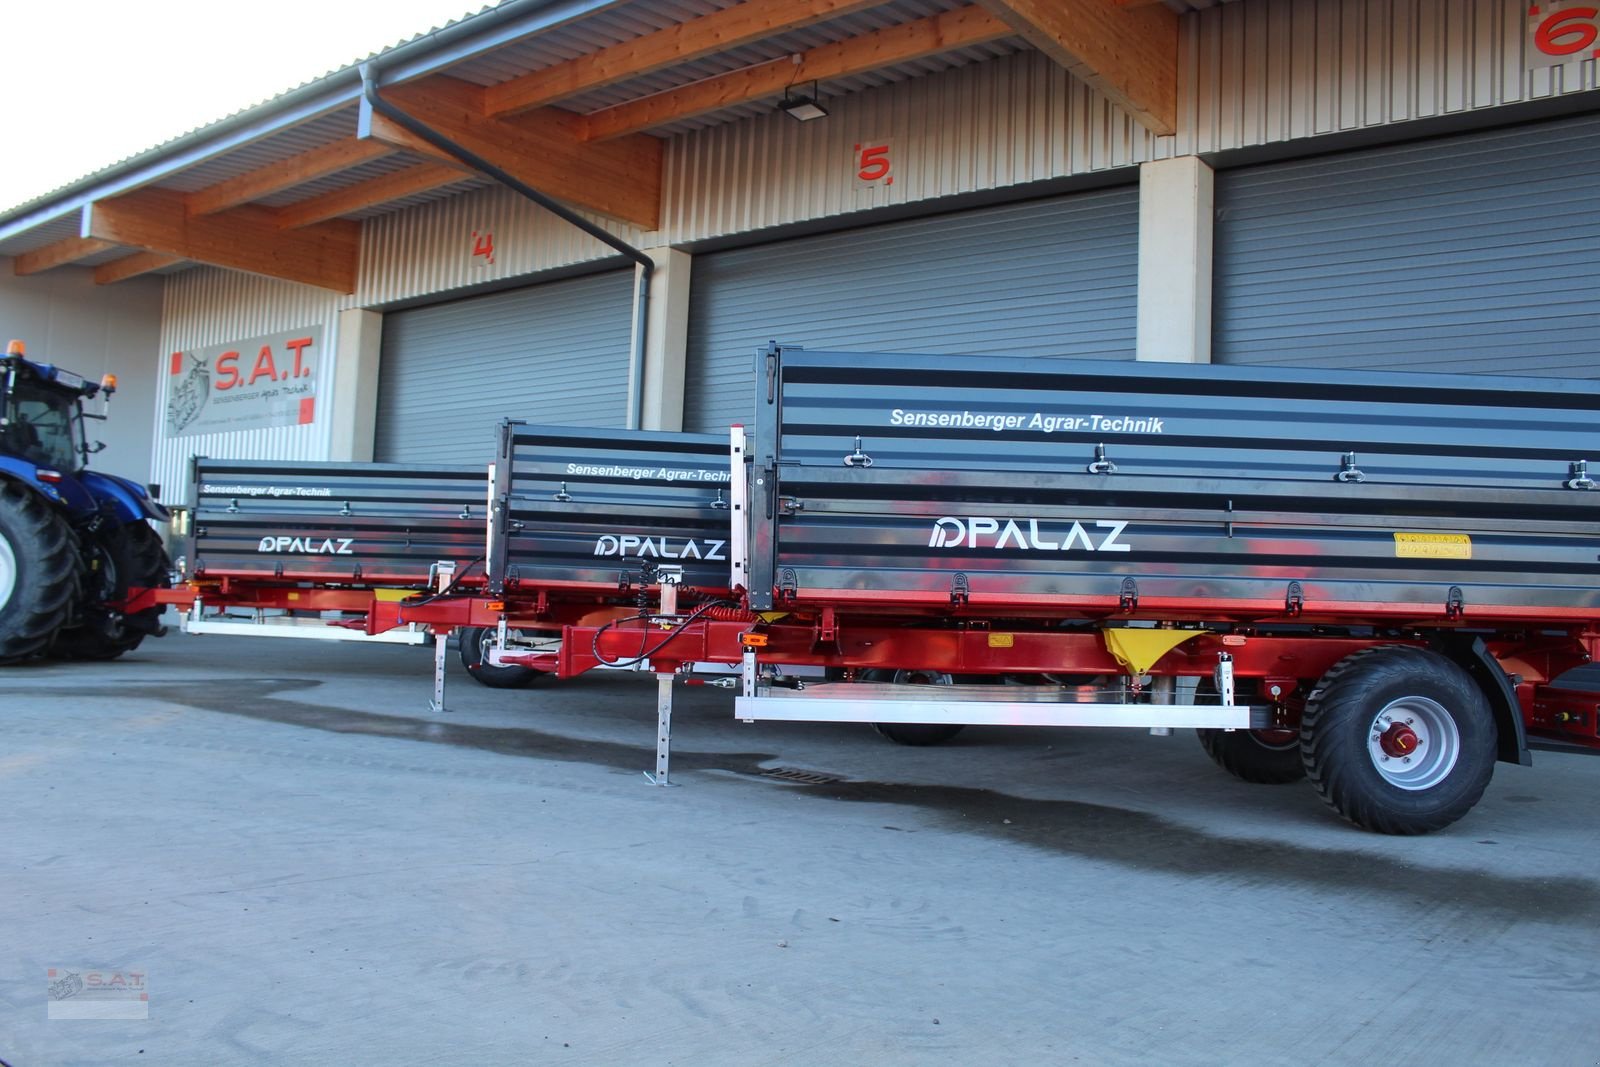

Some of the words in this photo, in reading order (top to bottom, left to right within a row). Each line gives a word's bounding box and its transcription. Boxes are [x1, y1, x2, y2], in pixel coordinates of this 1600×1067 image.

[858, 145, 890, 181] 5
[215, 337, 312, 390] S.A.T.
[890, 408, 1025, 431] Sensenberger
[1028, 413, 1164, 433] Agrar-Technik
[566, 463, 656, 479] Sensenberger
[656, 467, 731, 482] Agrar-Tech
[203, 484, 267, 496] Sensenberger
[266, 486, 331, 497] Agrar-Technik
